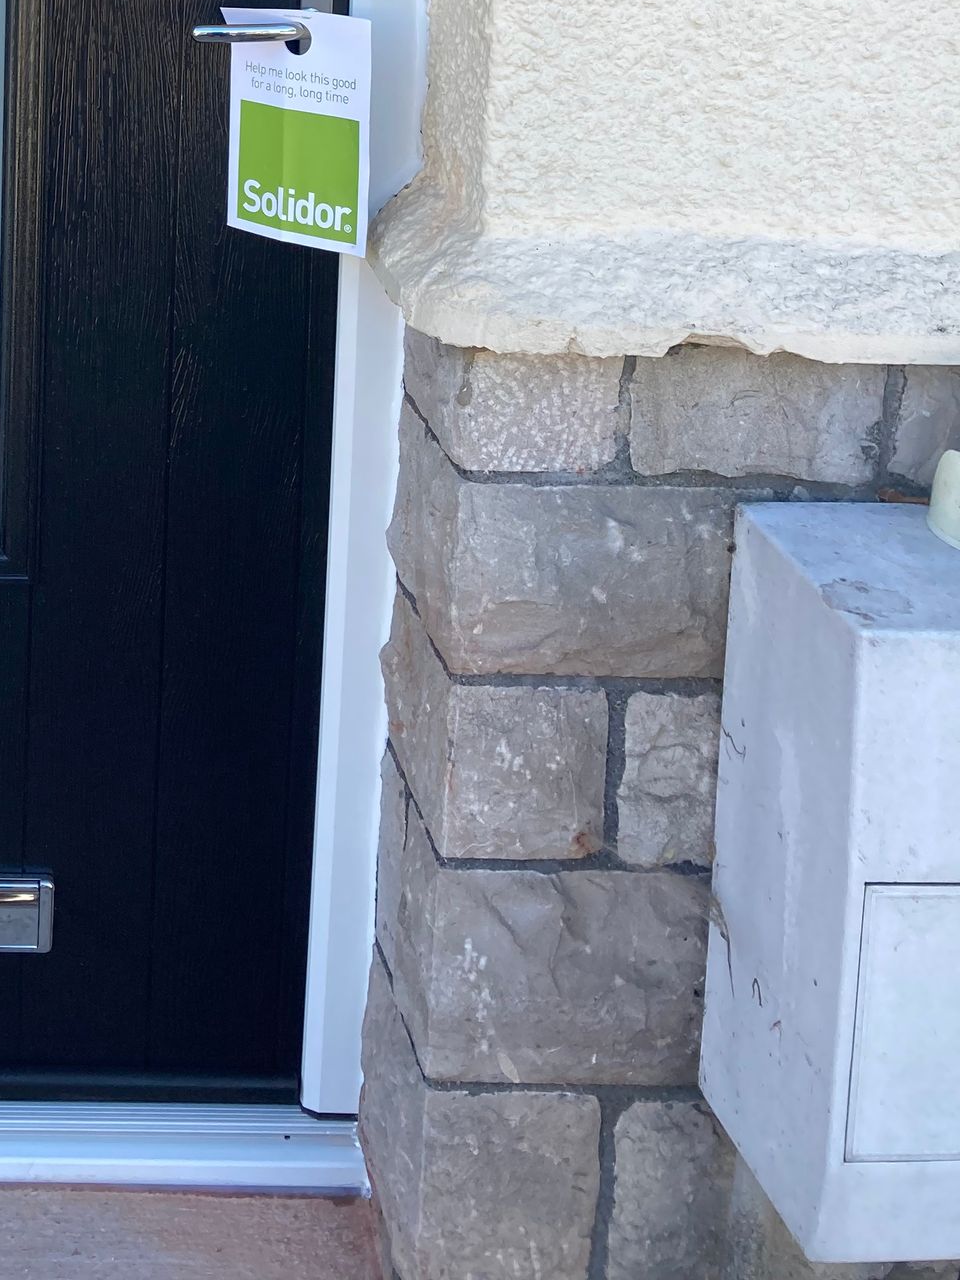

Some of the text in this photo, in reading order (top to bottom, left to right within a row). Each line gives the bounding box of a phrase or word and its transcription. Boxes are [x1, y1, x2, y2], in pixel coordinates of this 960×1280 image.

[245, 60, 357, 91] Help me look this good
[251, 77, 349, 104] for a long, long time
[242, 179, 353, 232] Solidor
